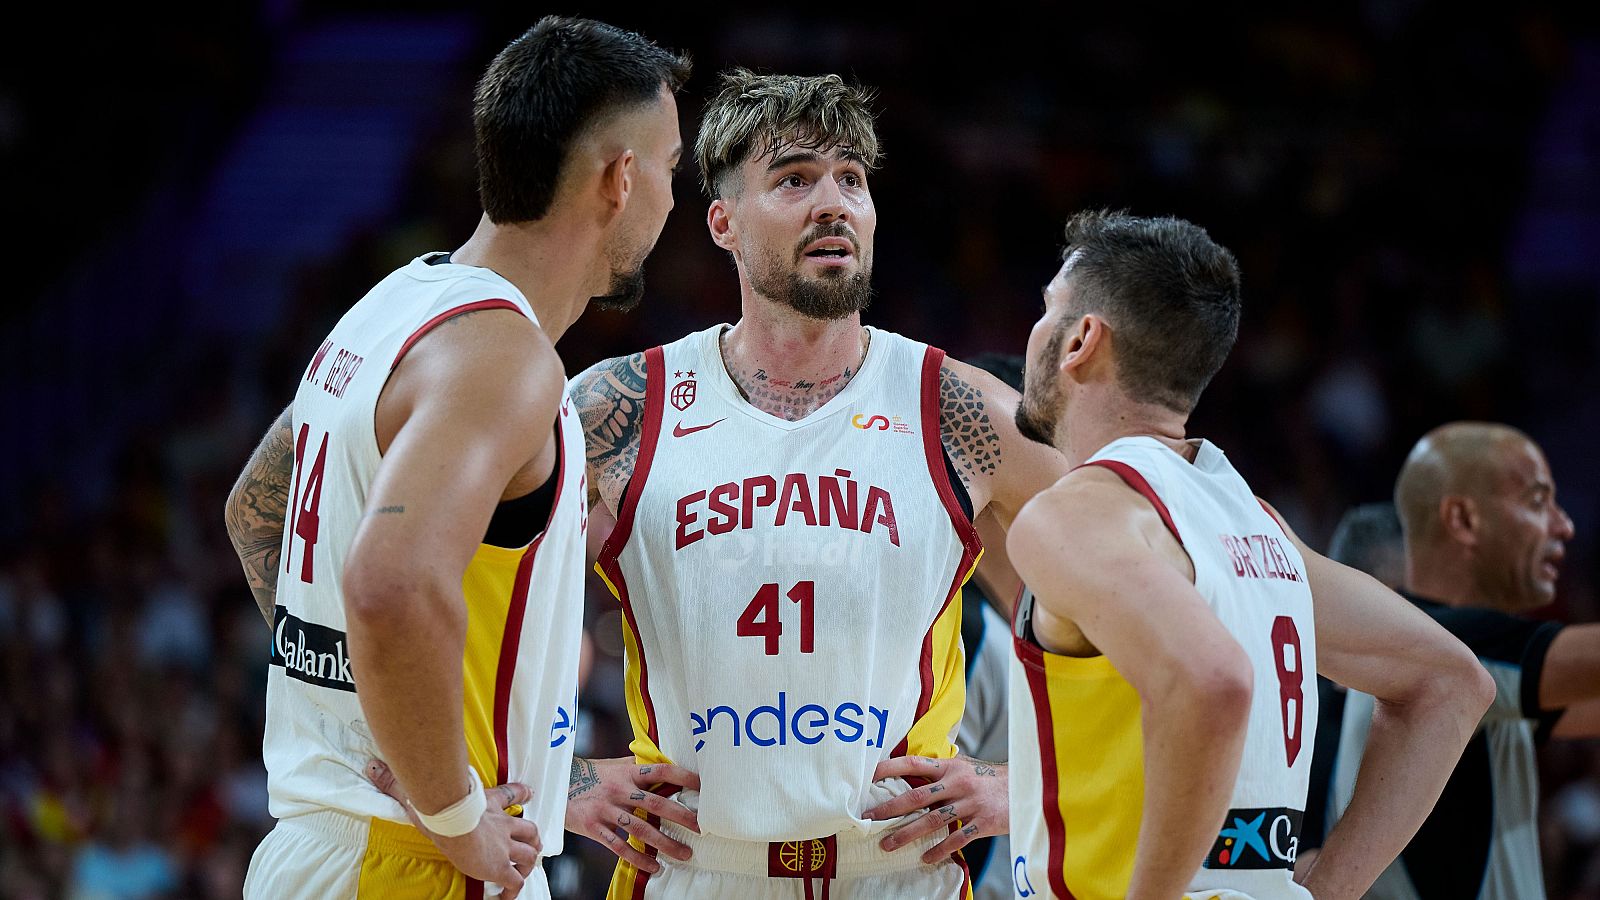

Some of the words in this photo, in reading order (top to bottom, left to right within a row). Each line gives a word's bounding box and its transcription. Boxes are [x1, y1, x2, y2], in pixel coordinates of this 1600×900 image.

[286, 422, 329, 585] 14
[676, 468, 901, 551] ESPAÑA
[736, 580, 815, 656] 41
[1270, 615, 1304, 769] 8
